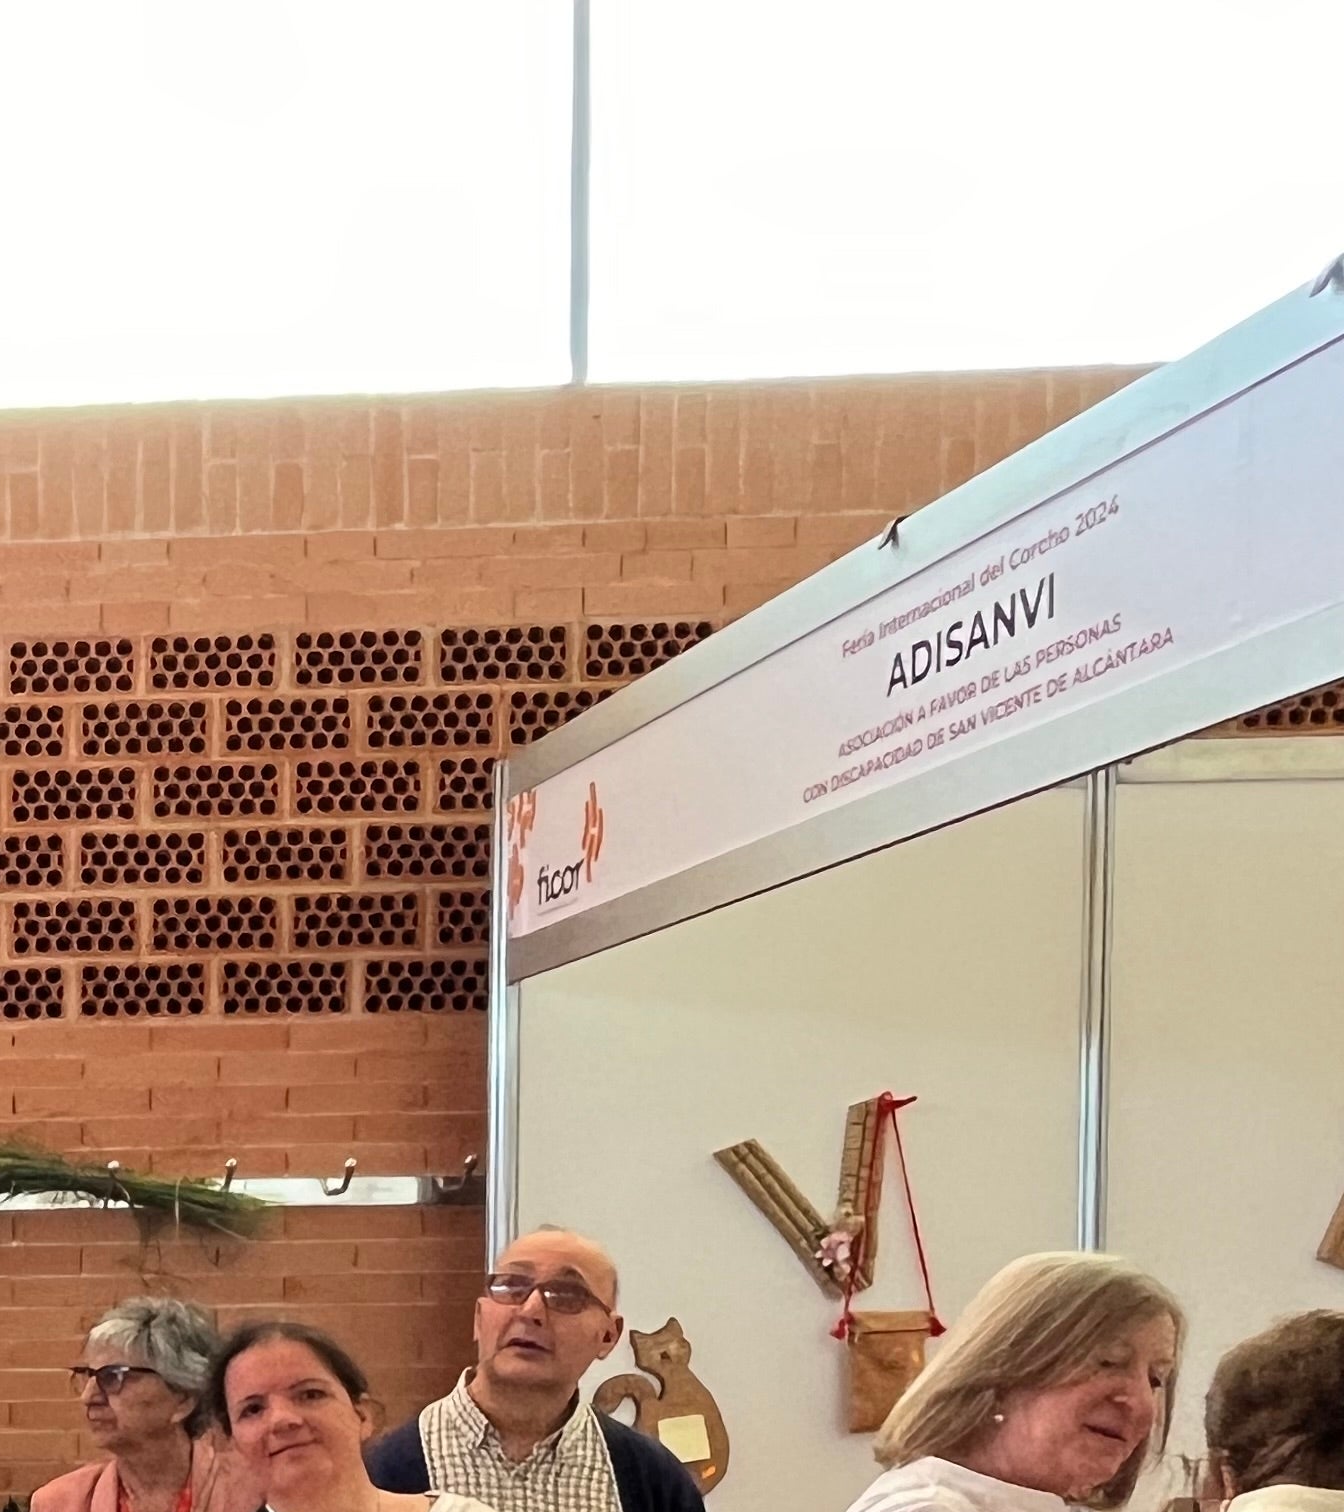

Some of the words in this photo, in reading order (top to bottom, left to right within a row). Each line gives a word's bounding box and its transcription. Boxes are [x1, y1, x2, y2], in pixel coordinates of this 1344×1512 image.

[841, 631, 875, 658] Feria
[878, 572, 976, 640] Internacional
[979, 555, 1006, 587] del
[1008, 525, 1070, 570] Corcho
[1074, 493, 1120, 538] 2024
[886, 571, 1055, 697] ADISANVI
[803, 780, 829, 804] CON
[830, 740, 923, 793] DISCAPACIDAD
[926, 726, 945, 749] DE
[948, 713, 978, 740] SAN
[981, 685, 1042, 724] VICENTE
[1046, 672, 1068, 699] DE
[1071, 627, 1175, 686] ALCÁNTARA
[837, 712, 913, 758] ASOCIACIÓN
[917, 705, 927, 722] A
[929, 685, 976, 717] FAVOR
[980, 669, 1000, 696] DE
[1004, 656, 1031, 682] LAS
[1035, 612, 1122, 669] PERSONAS
[537, 858, 585, 906] ficor
